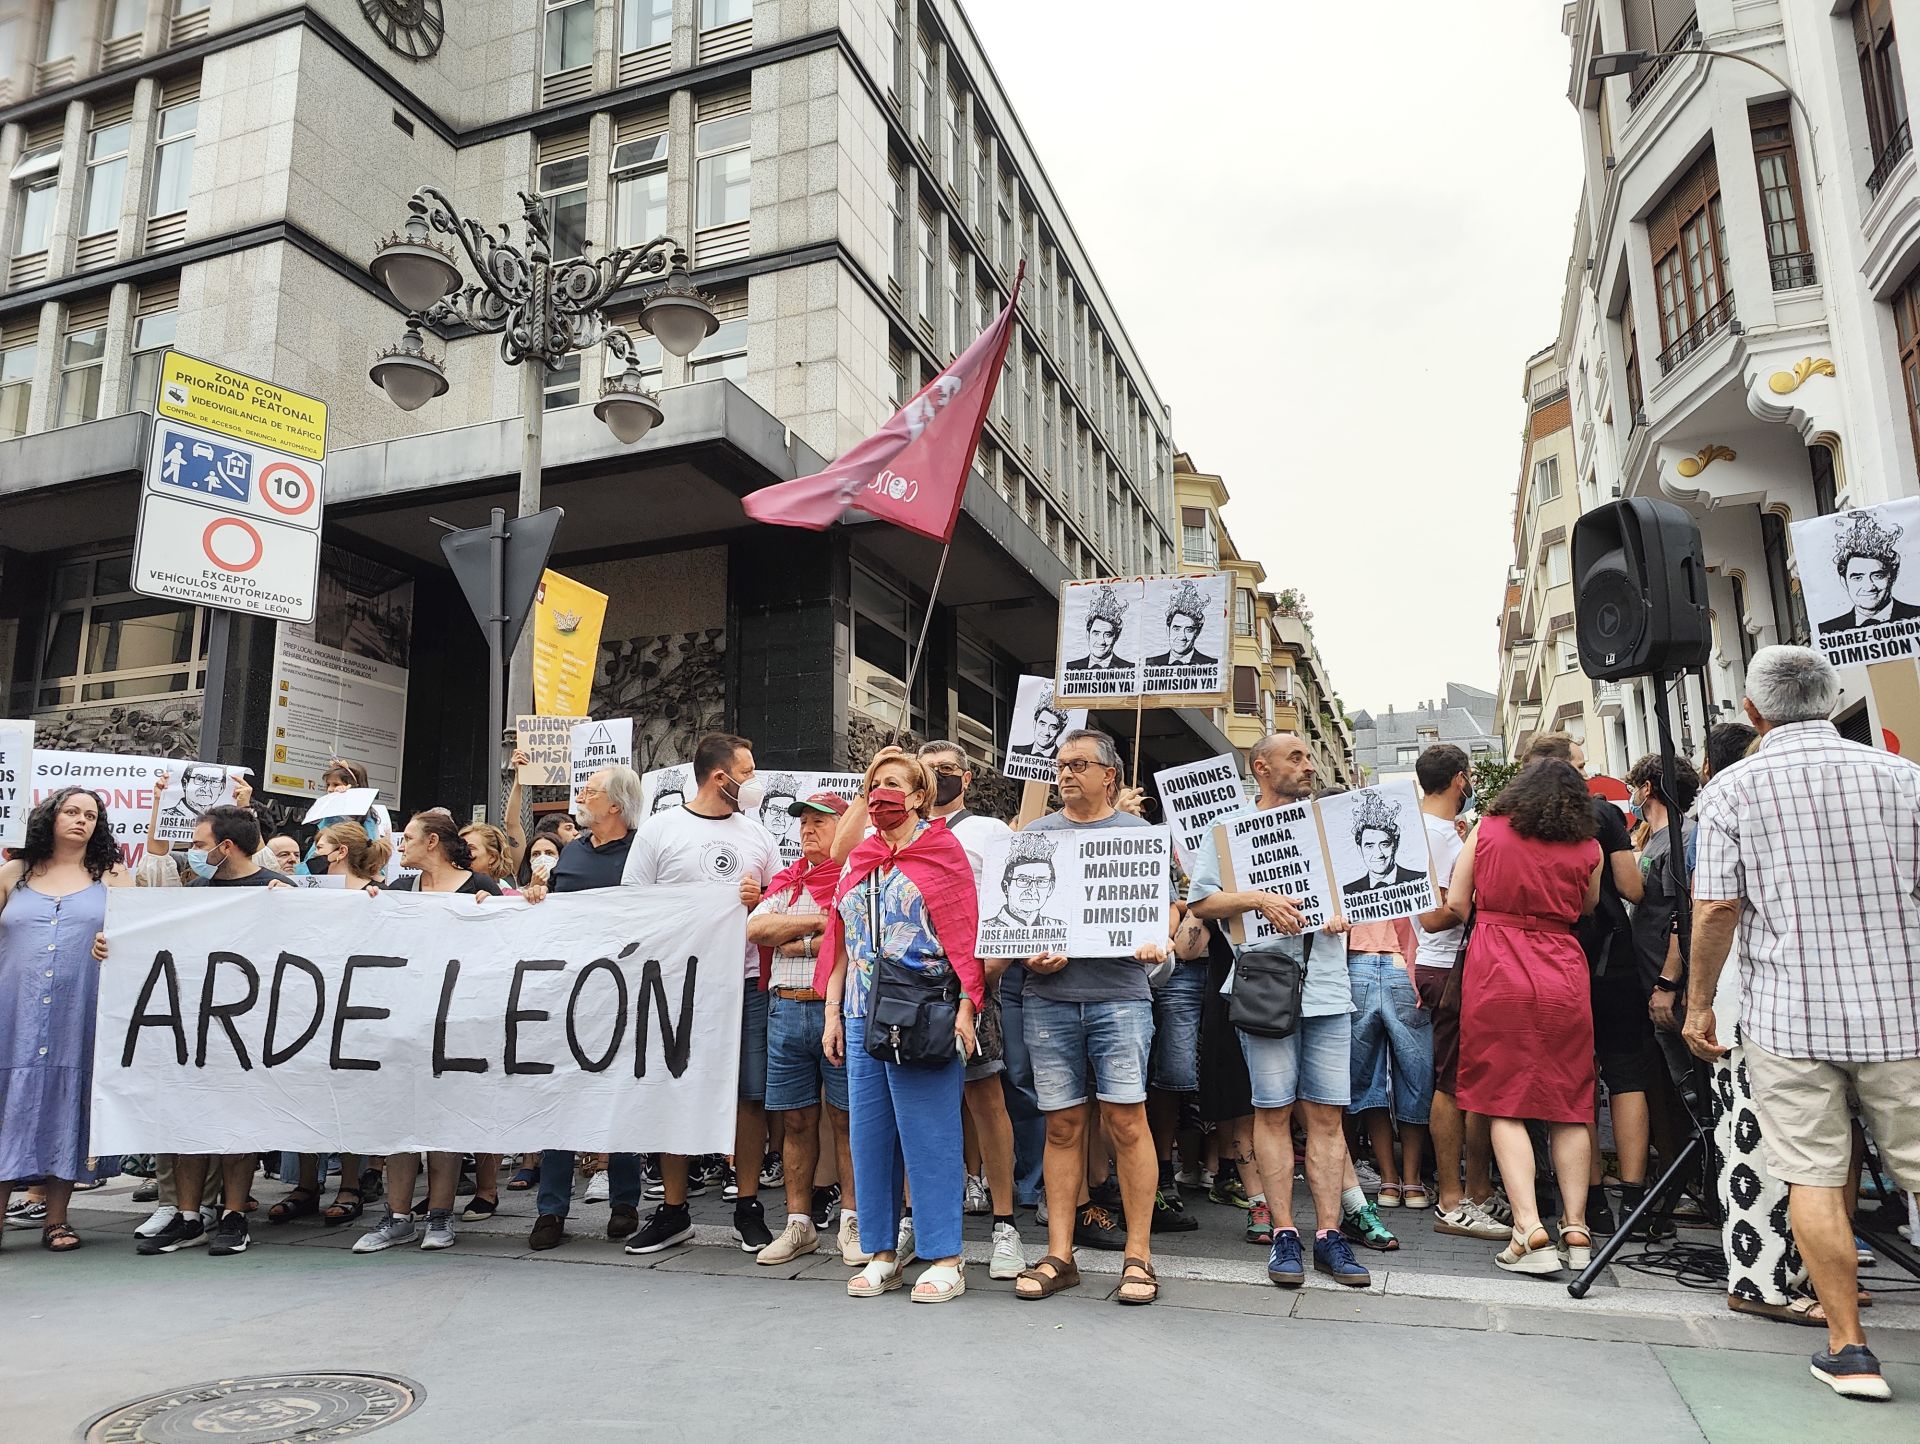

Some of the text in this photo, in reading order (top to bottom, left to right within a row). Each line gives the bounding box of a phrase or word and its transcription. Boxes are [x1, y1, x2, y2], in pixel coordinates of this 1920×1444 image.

[215, 373, 282, 402] ZONA CON
[176, 372, 315, 424] PRIORIDAD PEATONAL
[166, 405, 197, 419] CONTROL
[246, 429, 277, 443] DENUNCIA
[191, 395, 322, 441] VIDEOVIGILANCIA DE TRÁFICO
[274, 477, 300, 499] 10
[150, 570, 303, 606] VEHÍCULOS AUTORIZADOS
[203, 570, 256, 587] EXCEPTO
[162, 585, 290, 614] AYUNTAMIENTO DE LEÓN
[1819, 621, 1920, 650] SUAREZ-QUIÑON
[1064, 670, 1136, 681] SUAREZ-QUIÑONES
[1143, 666, 1218, 678] SUAREZ-QUIÑONES
[1063, 680, 1135, 695] ¡DIMISIÓN YA!
[1143, 677, 1218, 692] ¡DIMISIÓN YA!
[585, 744, 616, 757] ¡POR LA
[37, 762, 146, 778] solamente
[818, 777, 849, 787] ¡APOYO
[1162, 765, 1236, 796] ¡QUIÑONES,
[1172, 785, 1237, 813] MAÑUECO
[1179, 816, 1188, 831] Y
[1234, 807, 1306, 836] ¡APOYO PARA
[1079, 837, 1167, 859] ¡QUIÑONES,
[1252, 828, 1296, 849] OMAÑA,
[1084, 860, 1161, 879] MAÑUECO
[1248, 860, 1311, 885] VALDERÍA Y
[1084, 884, 1159, 901] Y ARRANZ
[1294, 879, 1310, 893] DE
[1344, 881, 1430, 909] SUAREZ-QUIÑONES
[1414, 892, 1432, 909] YA!
[1083, 904, 1159, 924] DIMISIÓN
[1032, 928, 1067, 939] ARRANZ
[1108, 930, 1133, 947] YA!
[978, 943, 1067, 955] ¡DESTITUCIÓN YA!
[121, 941, 699, 1078] ARDE LEÓN
